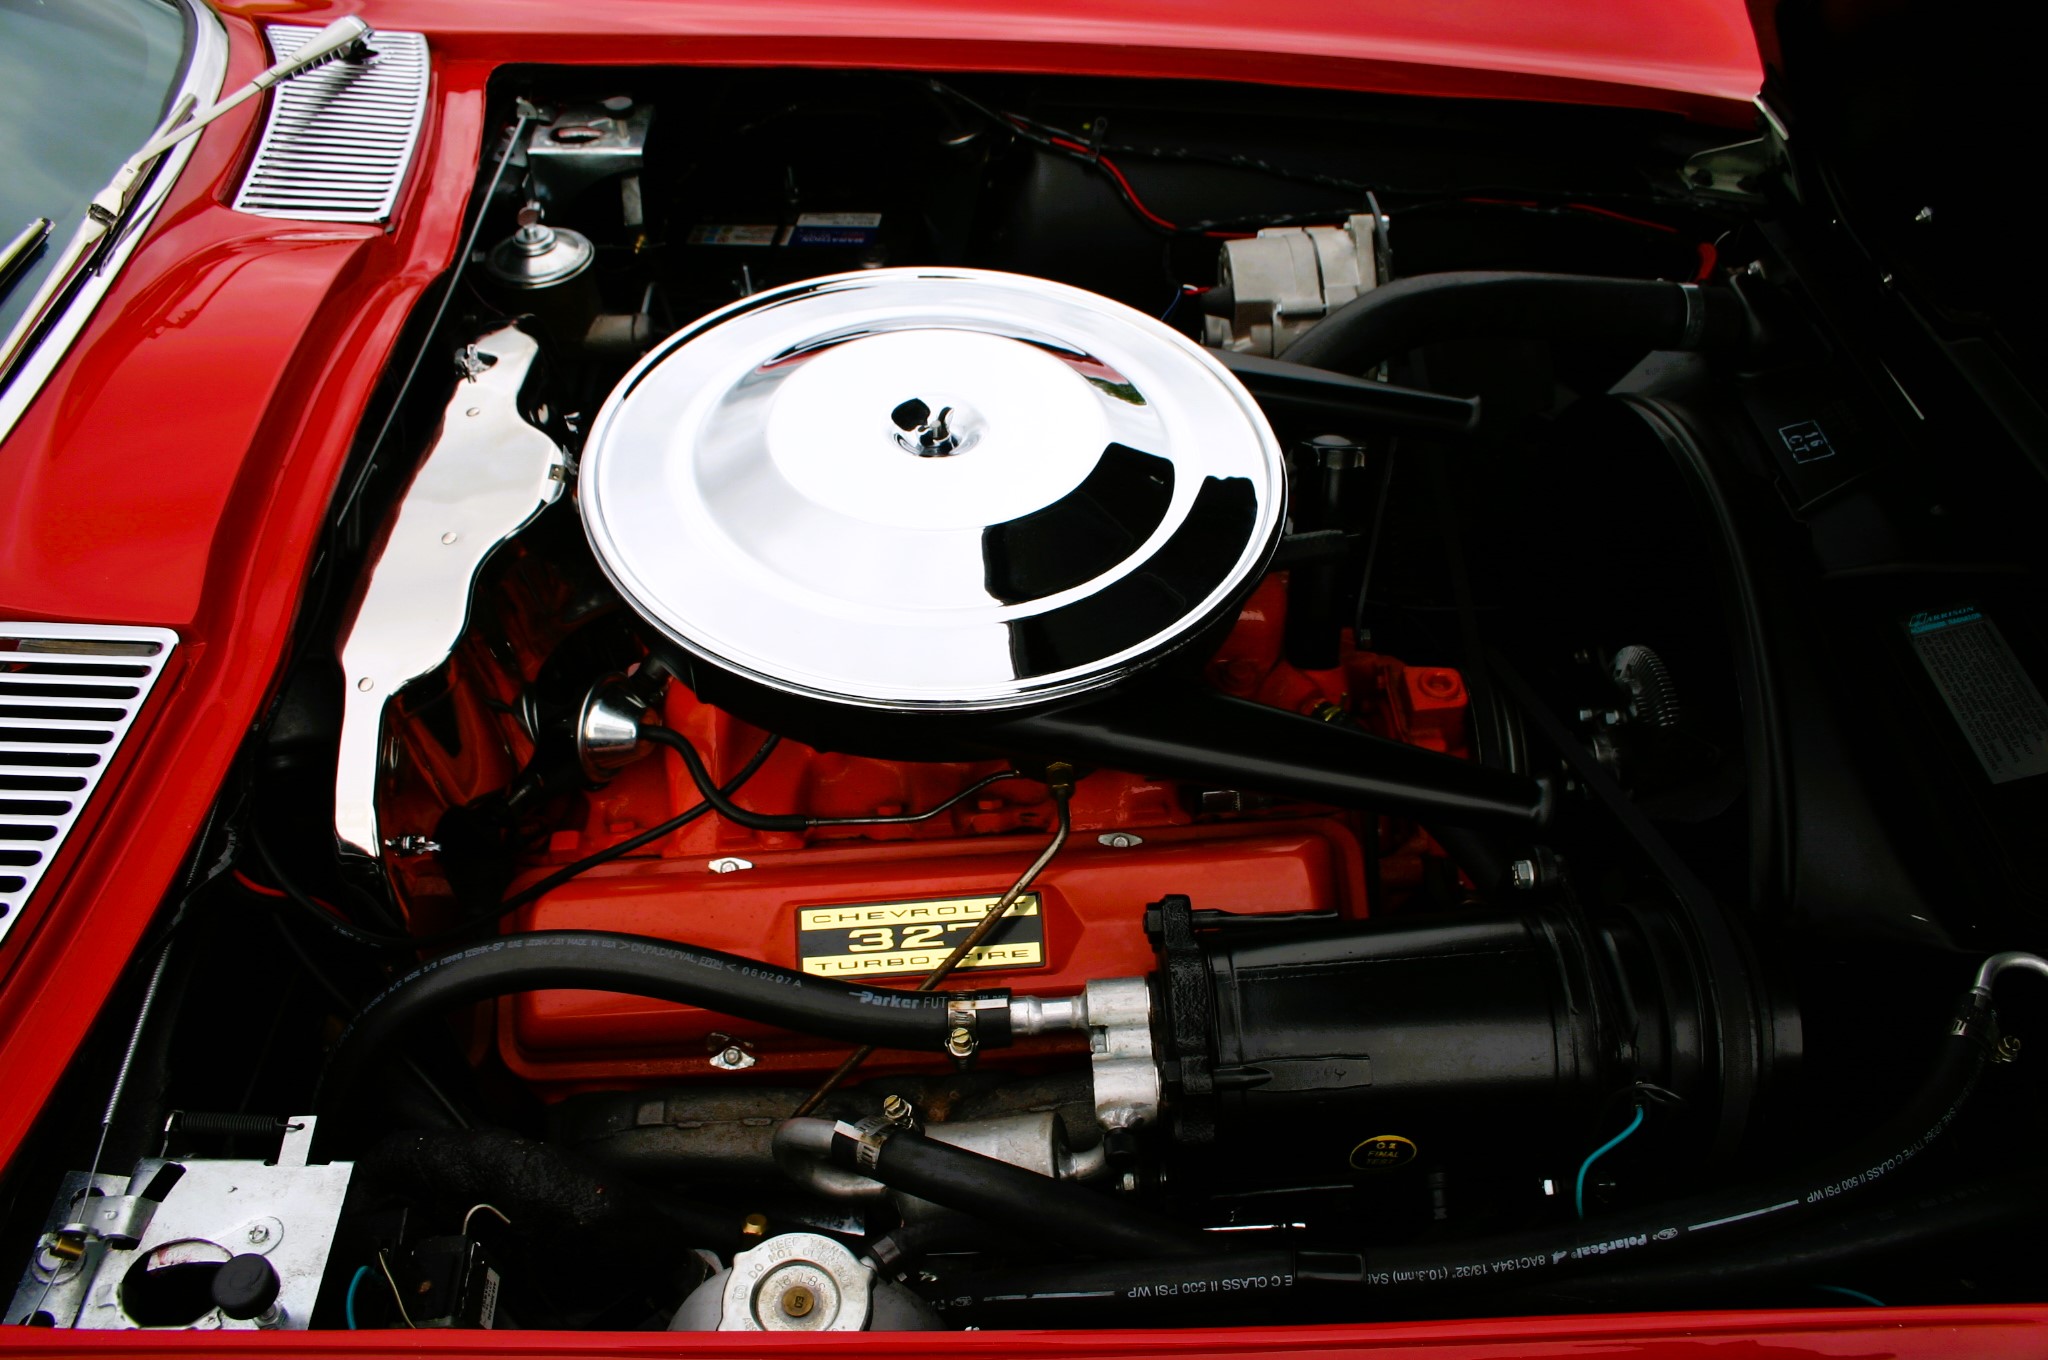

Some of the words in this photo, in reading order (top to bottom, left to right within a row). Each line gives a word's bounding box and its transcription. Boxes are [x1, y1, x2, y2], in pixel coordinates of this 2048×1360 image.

[848, 922, 980, 952] 32
[850, 991, 920, 1010] Parker
[1367, 1150, 1401, 1158] FINAL
[1865, 1158, 1896, 1181] CLASS
[1822, 1183, 1842, 1197] PSI
[1839, 1176, 1860, 1191] 500
[1805, 1189, 1825, 1204] WP
[747, 1263, 765, 1279] DO
[768, 1249, 793, 1263] NOT
[1490, 1254, 1546, 1272] 8AC134A
[1154, 1284, 1178, 1296] PSI
[1181, 1281, 1206, 1294] 500
[1222, 1276, 1268, 1290] CLASS
[1127, 1285, 1152, 1298] WP
